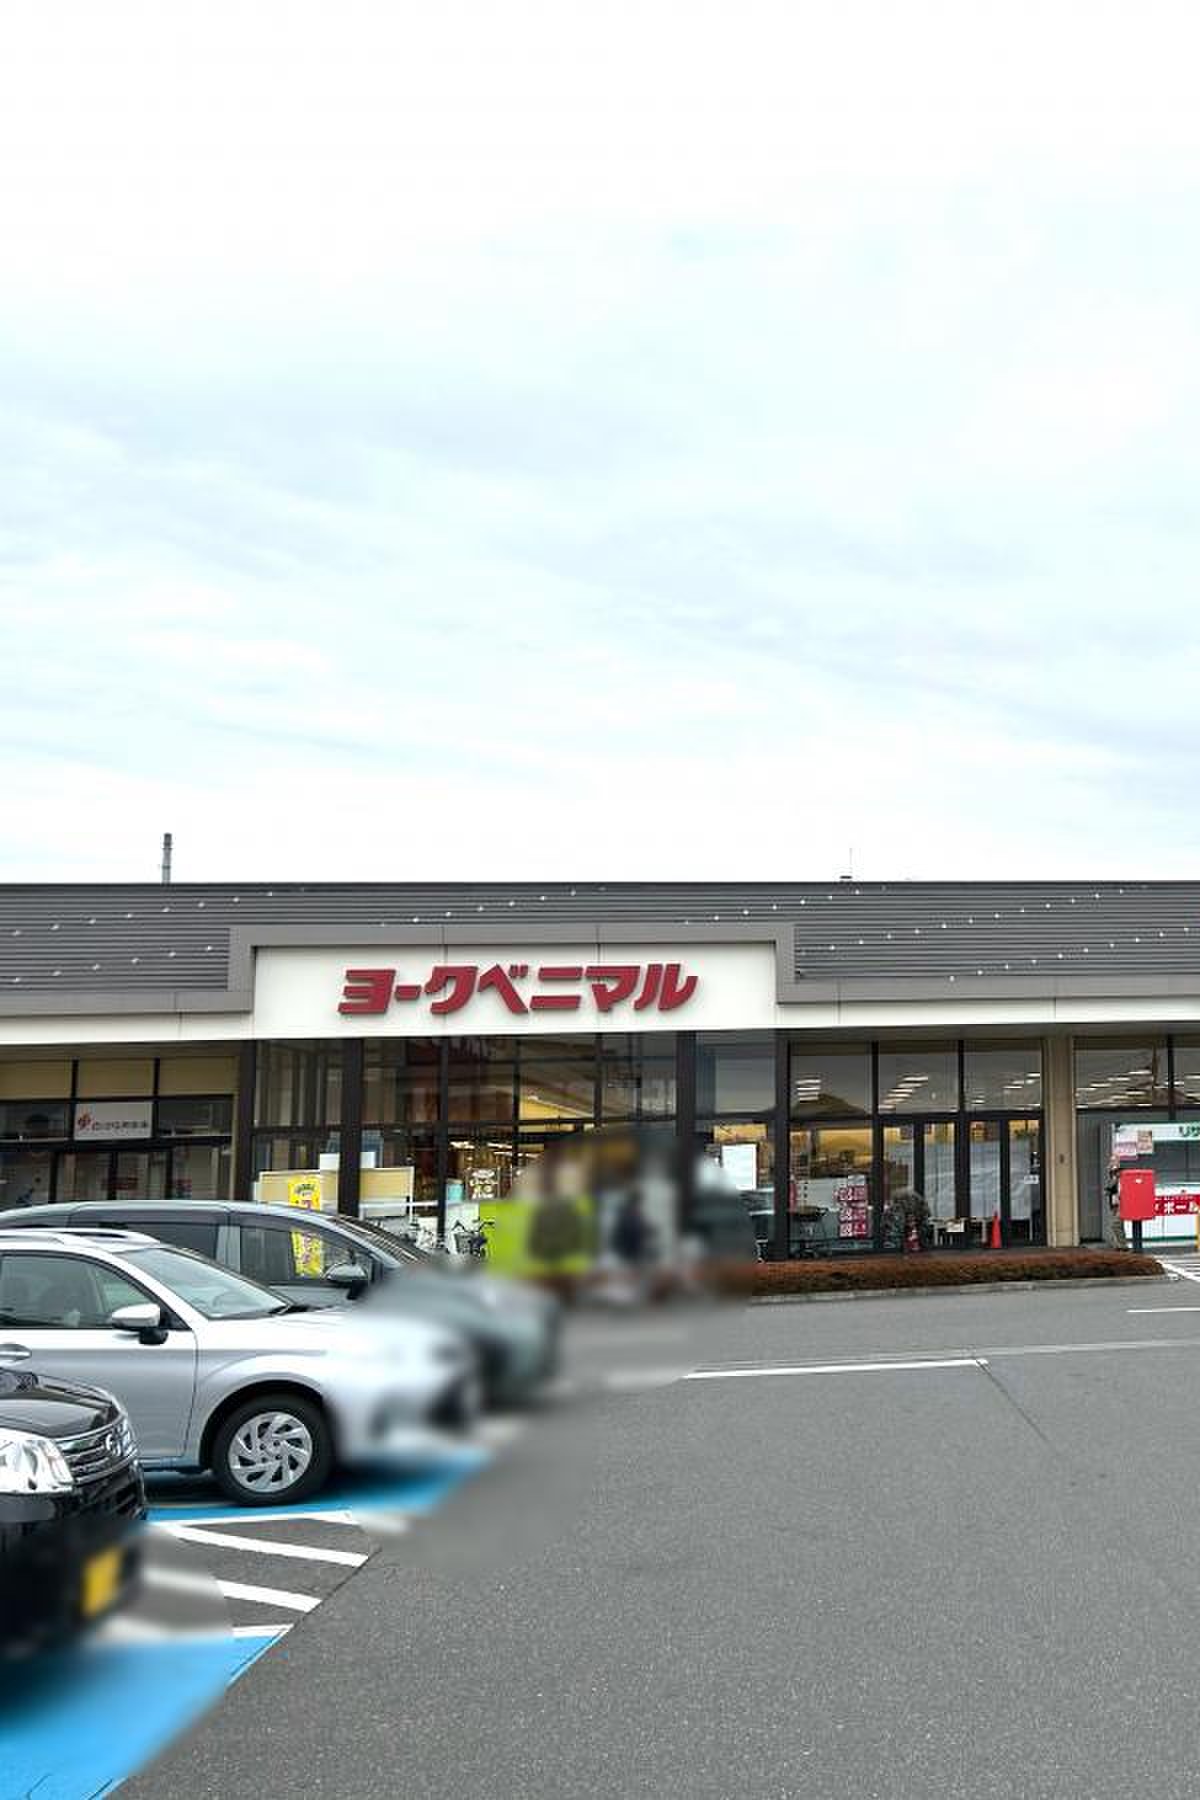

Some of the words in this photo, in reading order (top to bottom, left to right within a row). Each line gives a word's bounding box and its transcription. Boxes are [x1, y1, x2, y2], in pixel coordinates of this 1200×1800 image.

[337, 963, 699, 1015] ヨークベニマル
